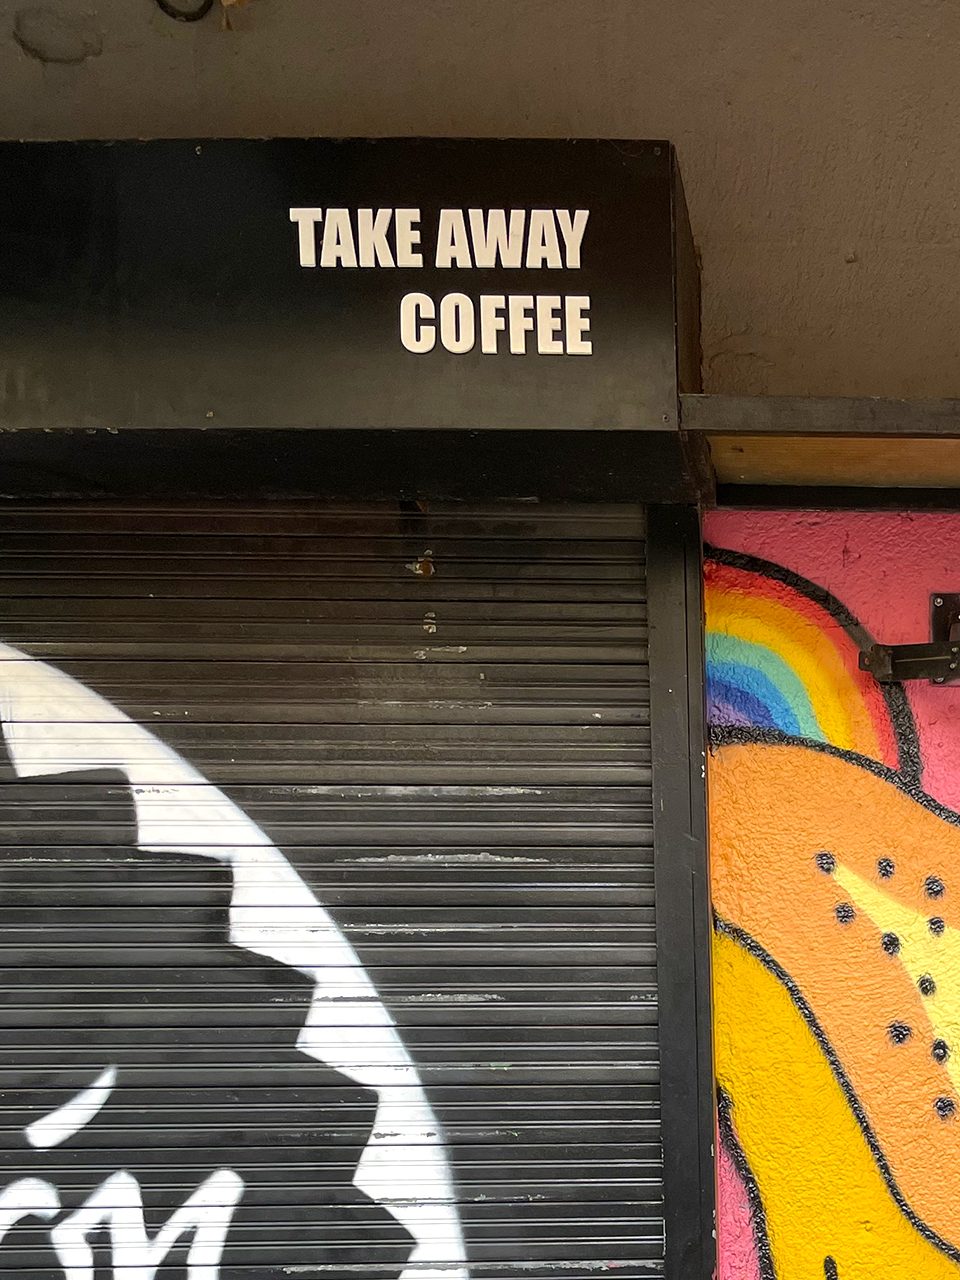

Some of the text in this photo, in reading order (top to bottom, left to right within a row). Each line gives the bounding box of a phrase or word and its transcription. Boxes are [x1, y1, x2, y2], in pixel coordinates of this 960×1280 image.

[289, 207, 590, 269] TAKE AWAY
[400, 292, 593, 355] COFFEE
